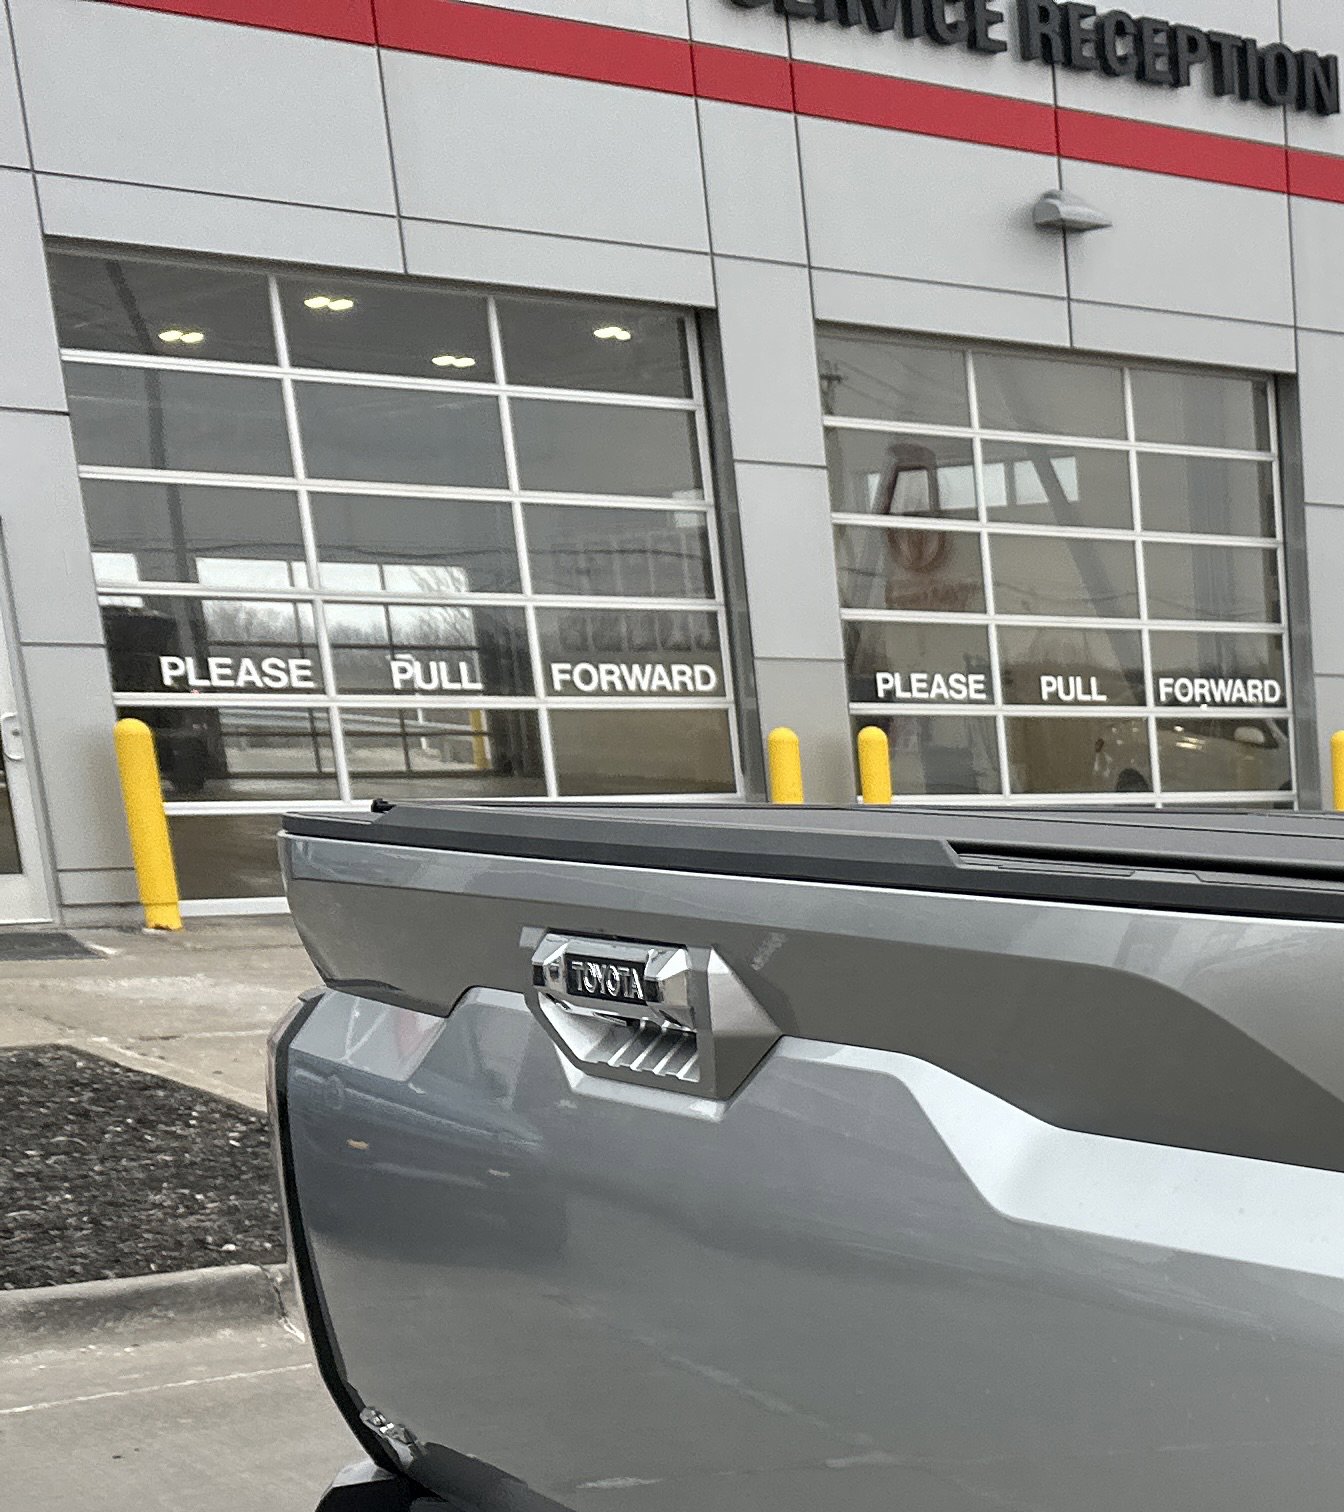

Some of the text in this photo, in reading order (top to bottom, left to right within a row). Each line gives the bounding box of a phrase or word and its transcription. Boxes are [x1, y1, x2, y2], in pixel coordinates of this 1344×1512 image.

[1017, 0, 1340, 116] RECEPTION
[159, 655, 718, 693] PLEASE PULL FORWARD
[875, 671, 1282, 703] PLEASE PULL FORWARD
[571, 960, 645, 1000] TOYOTA
